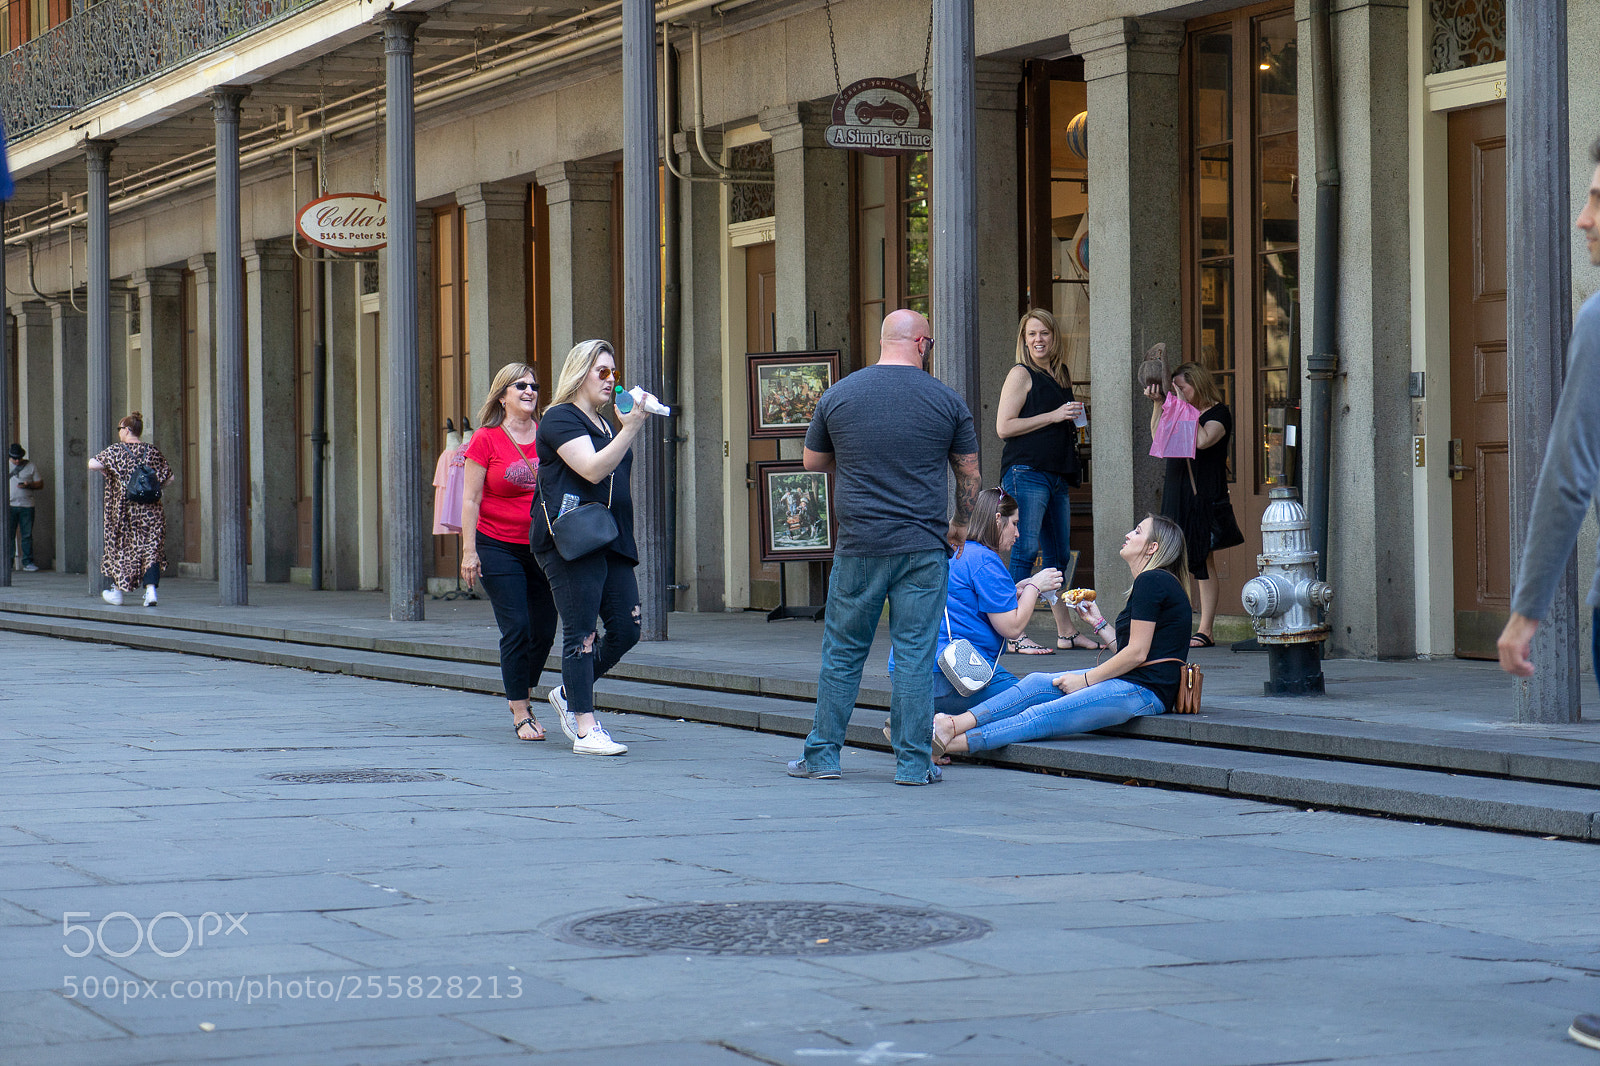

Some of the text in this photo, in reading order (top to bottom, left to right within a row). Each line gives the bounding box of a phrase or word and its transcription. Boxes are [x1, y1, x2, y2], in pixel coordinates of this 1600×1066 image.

[834, 129, 931, 147] A Simpler Time
[316, 203, 386, 227] Cella's
[320, 232, 337, 240] 514
[338, 232, 347, 240] S.
[349, 232, 373, 240] Peter
